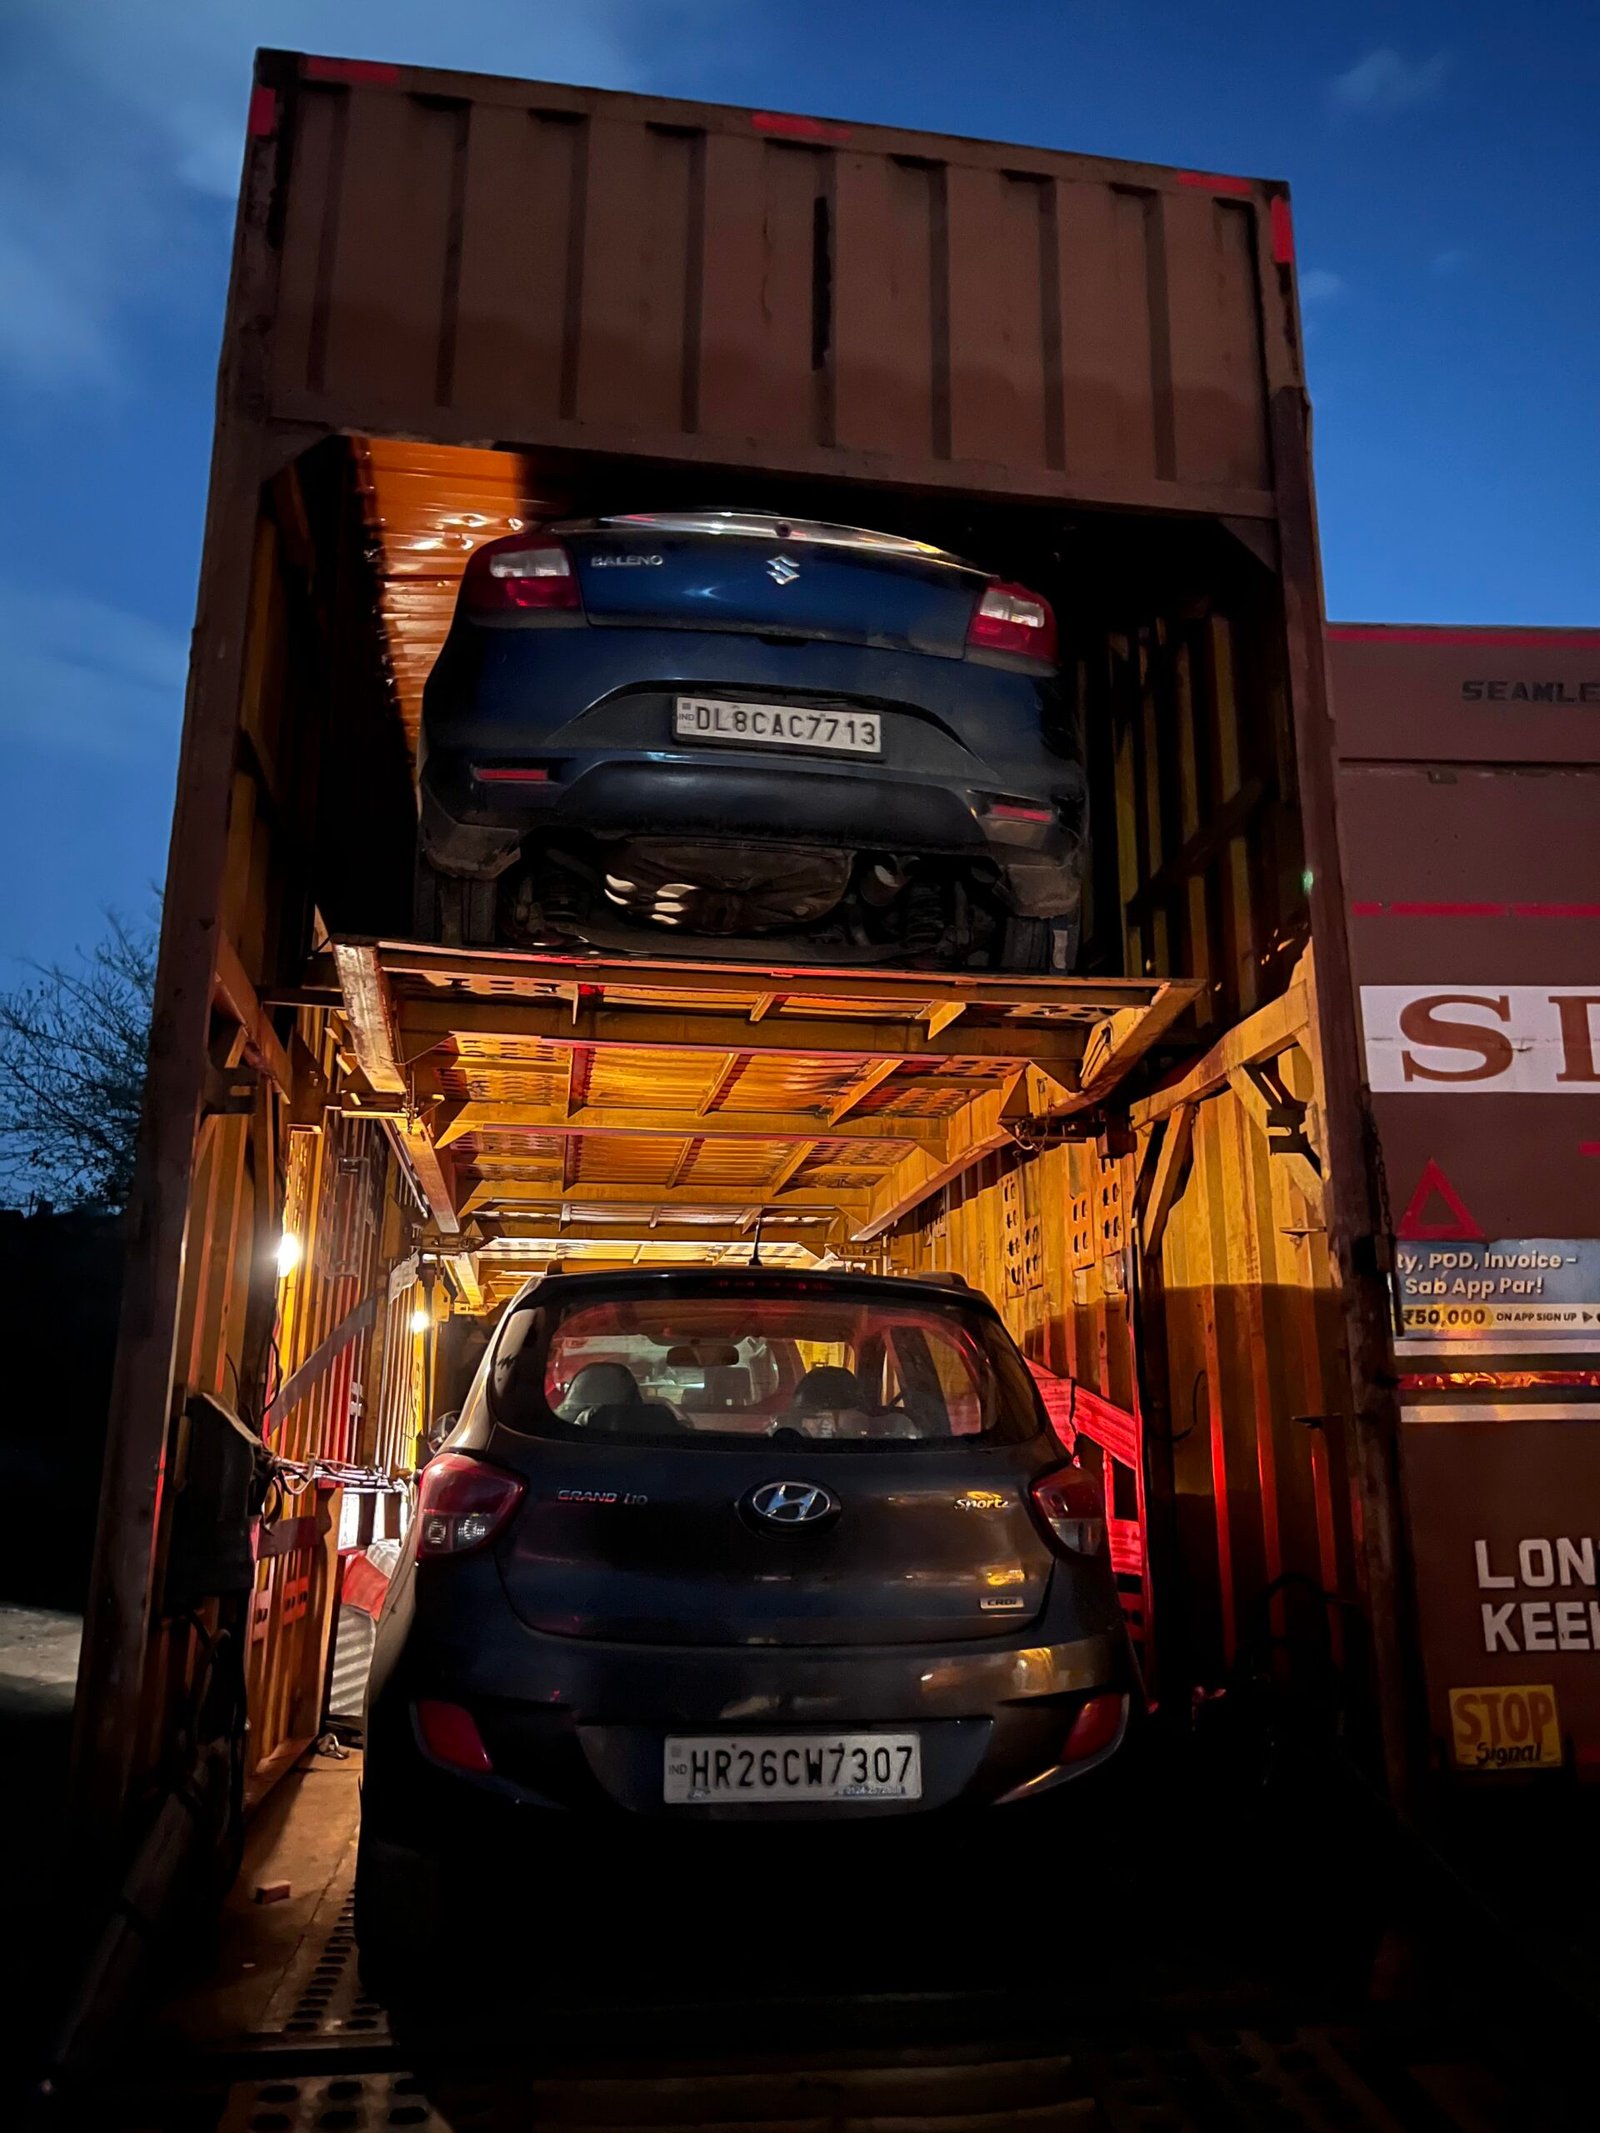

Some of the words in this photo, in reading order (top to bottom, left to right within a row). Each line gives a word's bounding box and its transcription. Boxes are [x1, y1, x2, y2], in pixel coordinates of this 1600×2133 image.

[591, 555, 664, 567] BALENO
[696, 706, 876, 746] DL8CAC7713
[1429, 1253, 1479, 1270] POD,
[1485, 1251, 1562, 1268] Invoice
[1405, 1278, 1447, 1295] Sab
[1451, 1280, 1495, 1299] App
[1500, 1276, 1543, 1294] Par!
[1496, 1312, 1511, 1321] ON
[1514, 1312, 1534, 1321] APP
[1537, 1312, 1561, 1321] SIGN
[1564, 1311, 1577, 1321] UP
[558, 1489, 618, 1503] GRAND
[1474, 1537, 1600, 1589] LON
[1455, 1691, 1554, 1745] STOP
[1476, 1742, 1541, 1767] Signal
[669, 1764, 687, 1775] IND
[692, 1746, 912, 1788] HR26CW7307
